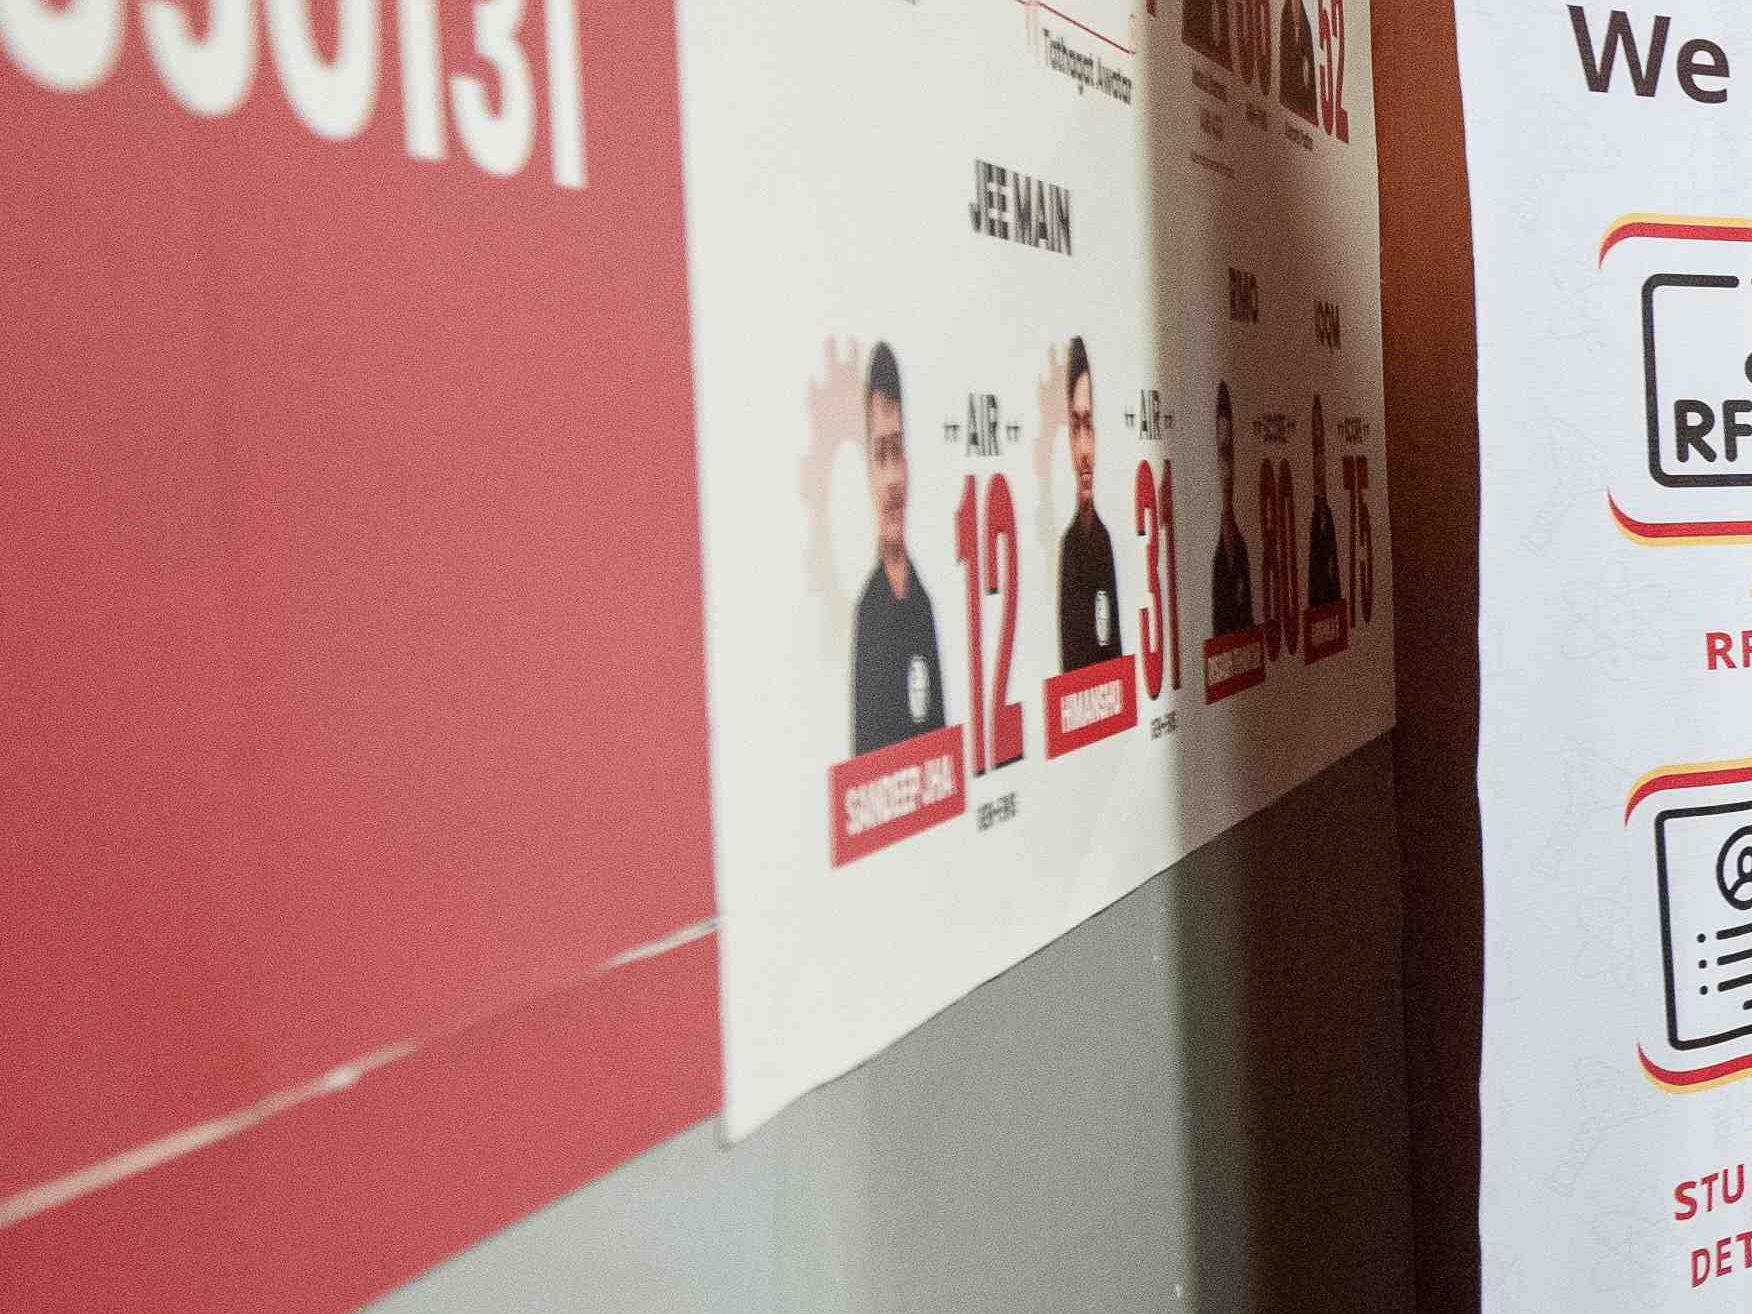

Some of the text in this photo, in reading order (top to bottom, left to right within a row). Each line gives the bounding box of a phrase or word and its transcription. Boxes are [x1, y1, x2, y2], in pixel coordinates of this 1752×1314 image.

[1567, 4, 1731, 106] We
[969, 159, 1073, 256] JEE MAIN
[966, 389, 1161, 457] AIR AIR
[1342, 455, 1374, 628] 75
[954, 458, 1182, 779] 12 31
[1060, 678, 1122, 734] HIMANSHU
[845, 764, 921, 837] SANDEEP
